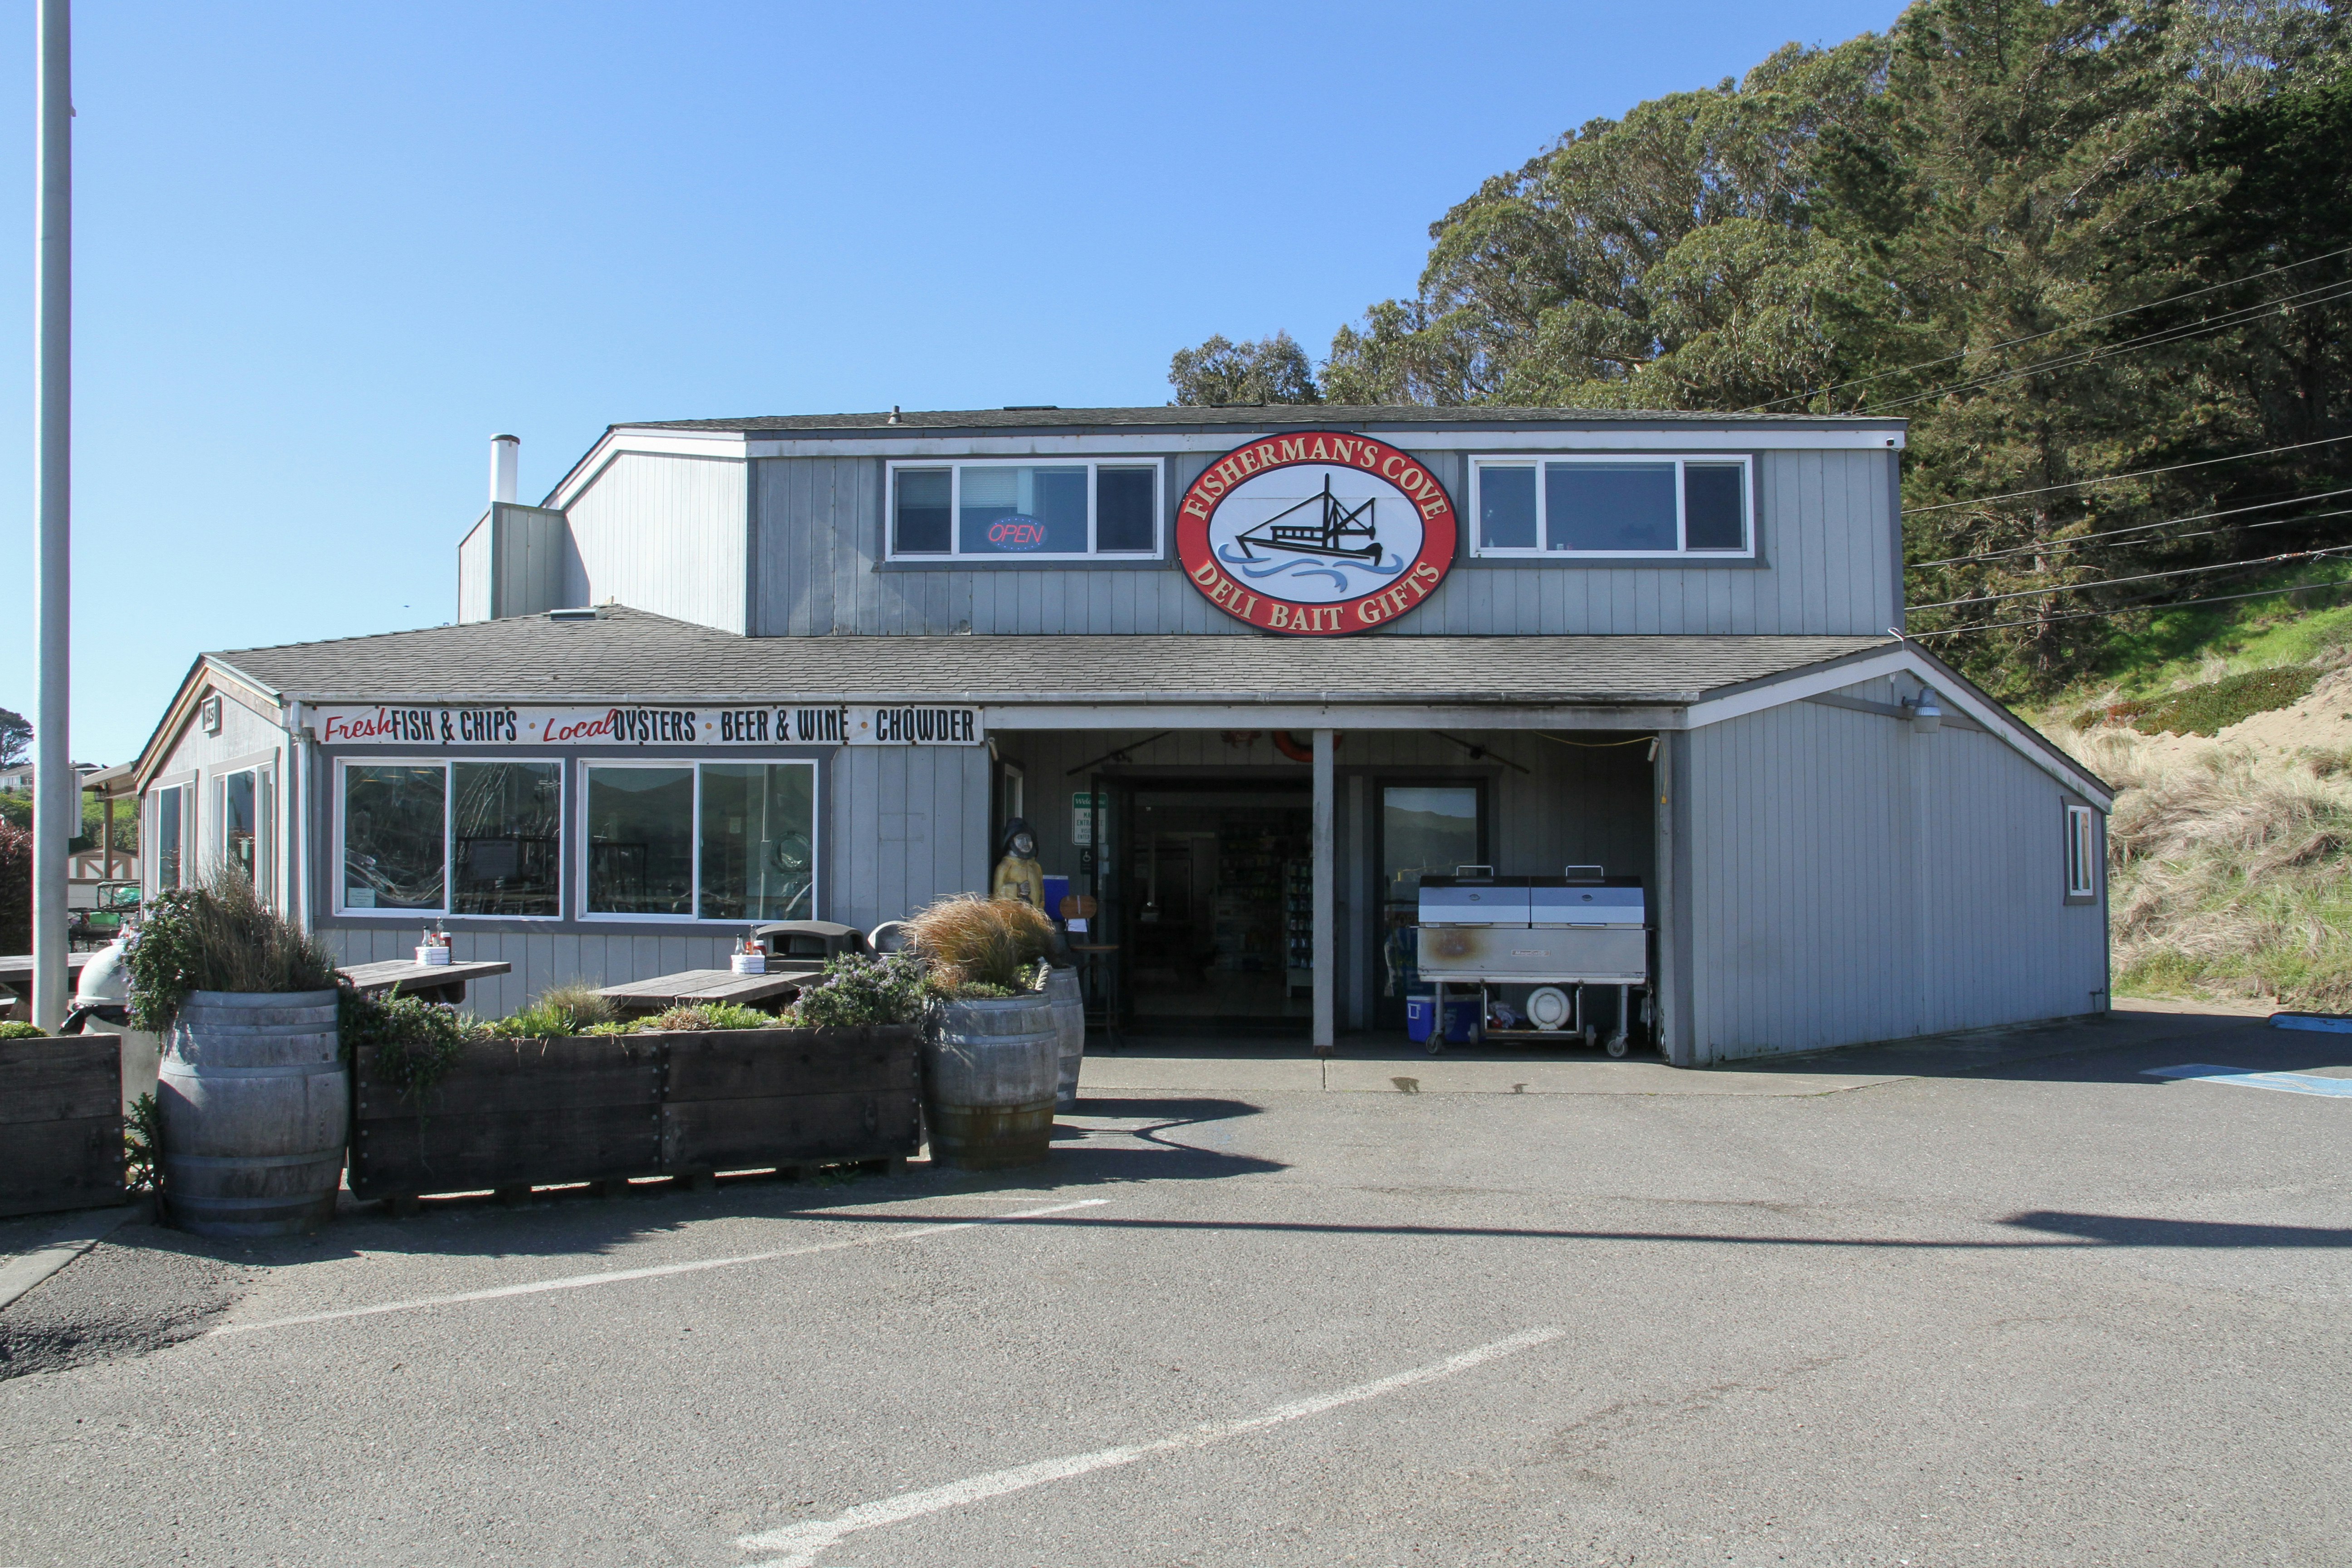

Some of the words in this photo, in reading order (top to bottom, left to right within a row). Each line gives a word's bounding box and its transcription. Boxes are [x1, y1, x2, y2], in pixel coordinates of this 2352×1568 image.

[1184, 437, 1378, 521] FISHERMAN'S
[1382, 456, 1447, 520] COVE
[989, 524, 1044, 542] OPEN
[1191, 560, 1258, 619] DELI
[1268, 604, 1343, 631] BAIT
[1357, 562, 1440, 623] GIFTS
[325, 708, 394, 742] Fresh
[392, 710, 435, 740] FISH
[441, 710, 456, 741] &
[460, 710, 517, 741] CHIPS
[543, 708, 617, 741] Local
[614, 710, 696, 741] OYSTERS
[721, 710, 769, 741] BEER
[776, 709, 790, 741] &
[797, 709, 850, 741] WINE
[876, 709, 974, 741] CHOWDER
